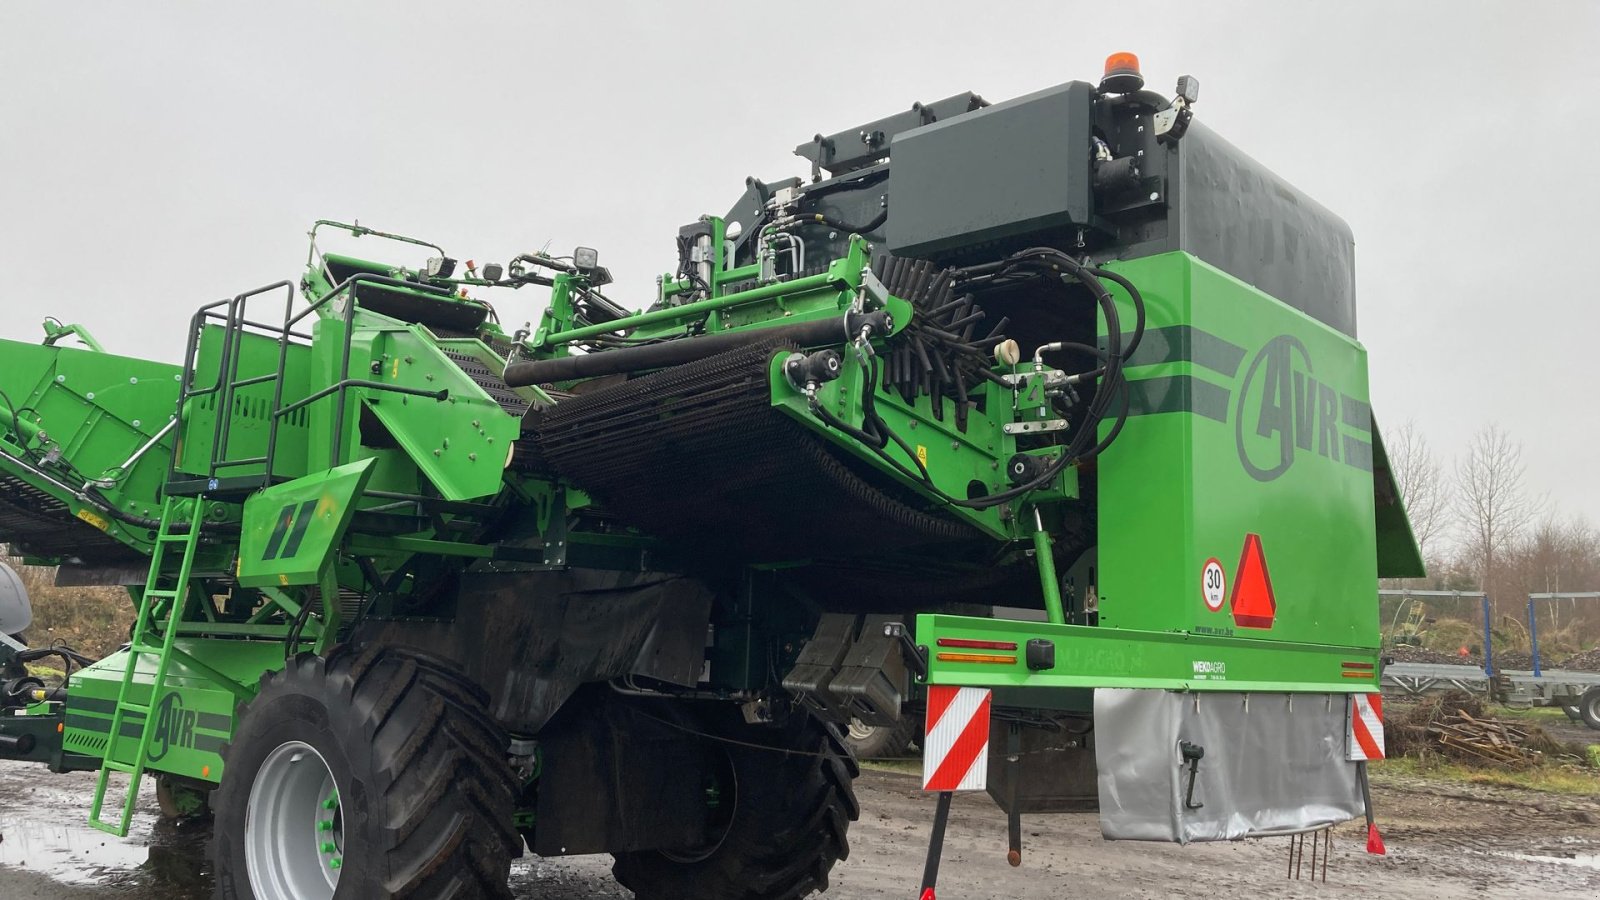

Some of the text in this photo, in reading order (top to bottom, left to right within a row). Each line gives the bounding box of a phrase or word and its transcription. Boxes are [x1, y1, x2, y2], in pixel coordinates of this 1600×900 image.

[1236, 334, 1340, 482] AVR
[1207, 569, 1220, 589] 30
[1211, 592, 1219, 601] km
[147, 691, 195, 762] AVR
